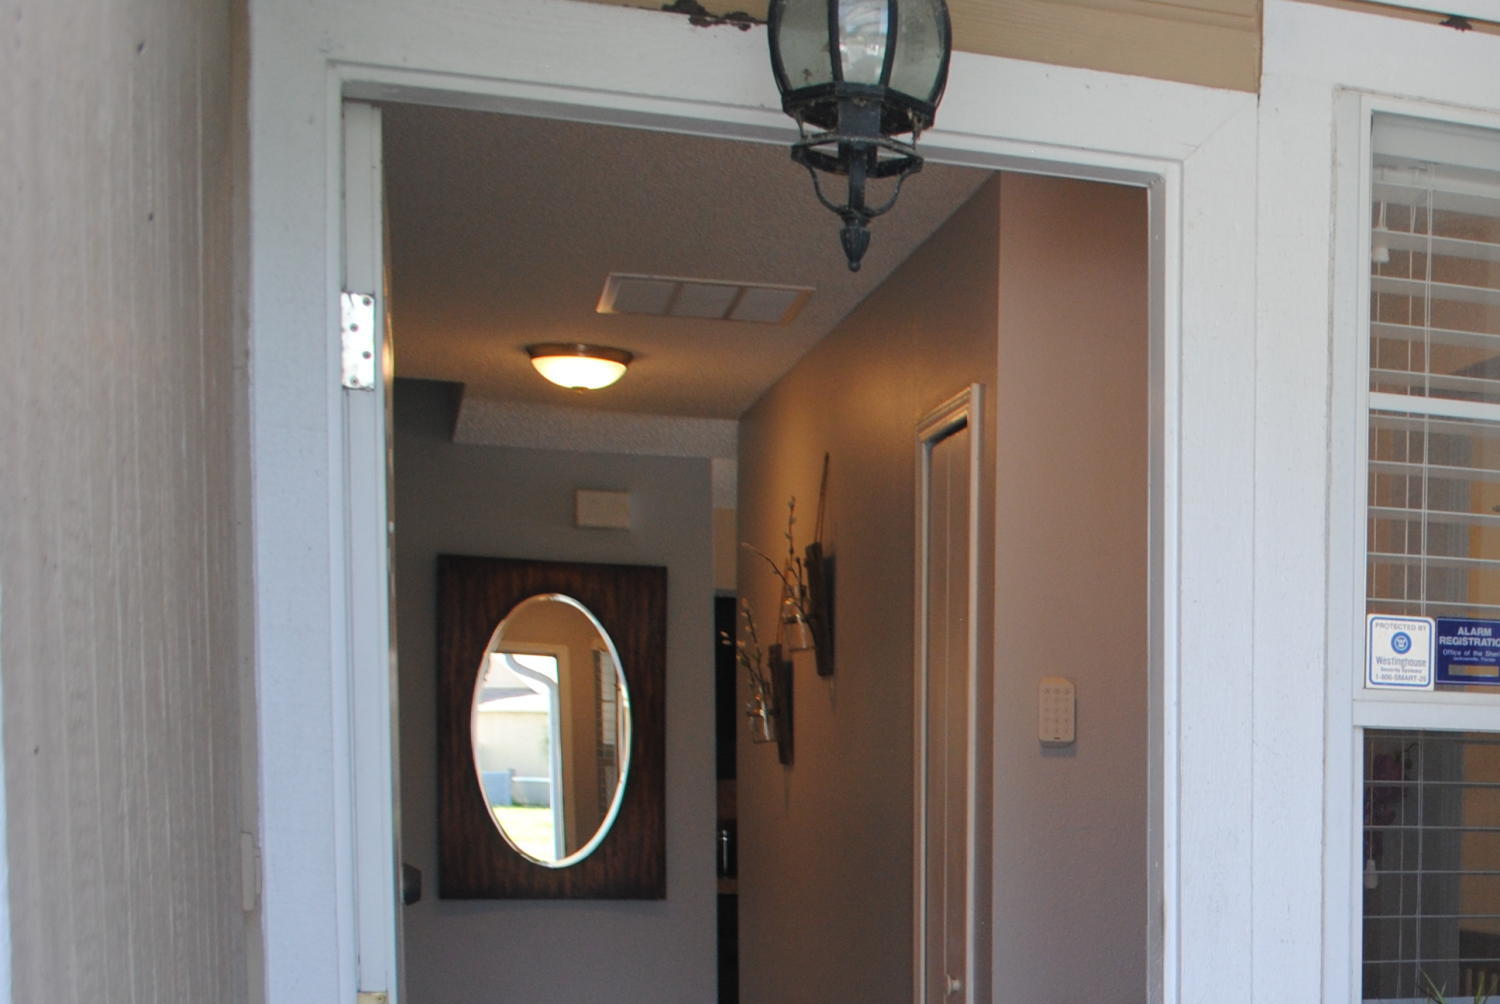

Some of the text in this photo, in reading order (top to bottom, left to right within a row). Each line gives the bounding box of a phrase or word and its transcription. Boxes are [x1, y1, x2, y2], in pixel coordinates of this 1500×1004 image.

[1375, 623, 1416, 631] PROTECTED
[1457, 626, 1492, 636] ALARM
[1442, 649, 1461, 657] Office
[1376, 656, 1427, 668] Westinghouse
